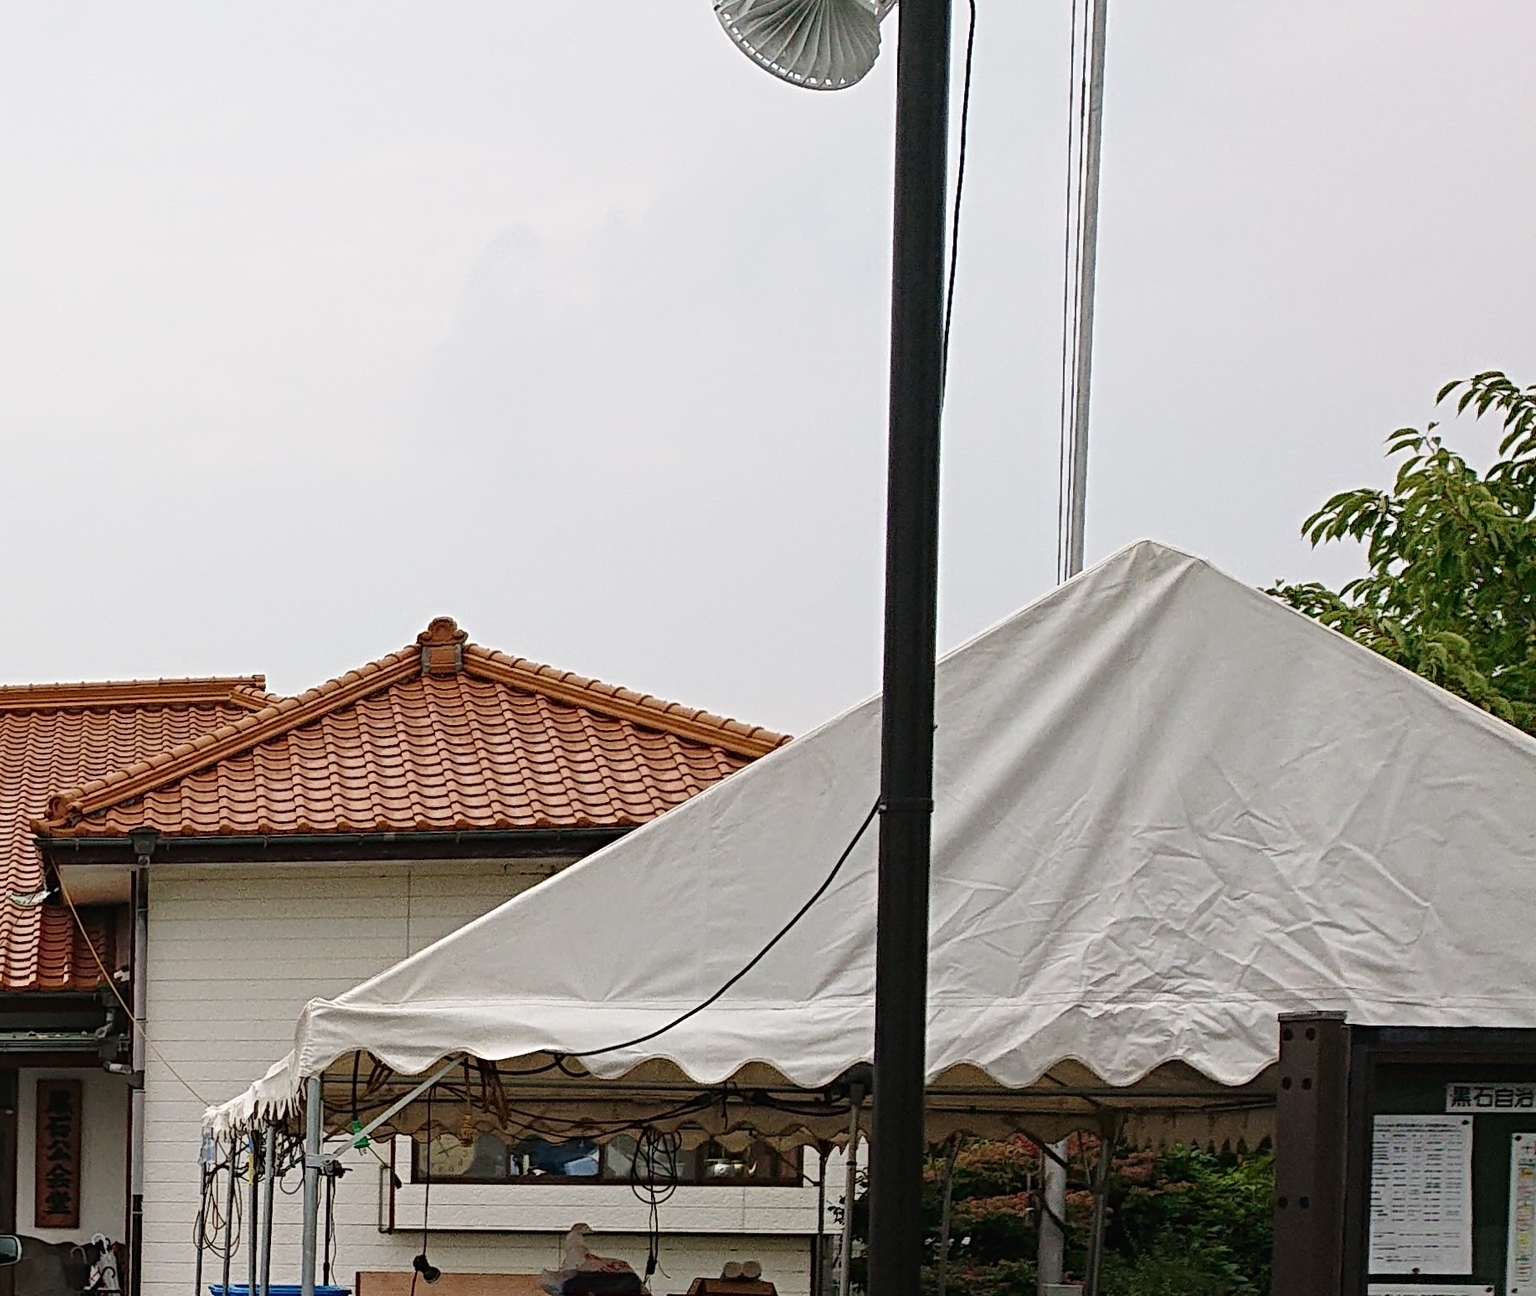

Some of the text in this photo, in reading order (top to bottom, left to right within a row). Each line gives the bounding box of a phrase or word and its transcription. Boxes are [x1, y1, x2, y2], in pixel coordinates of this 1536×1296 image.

[43, 1090, 73, 1215] 黒石公会堂
